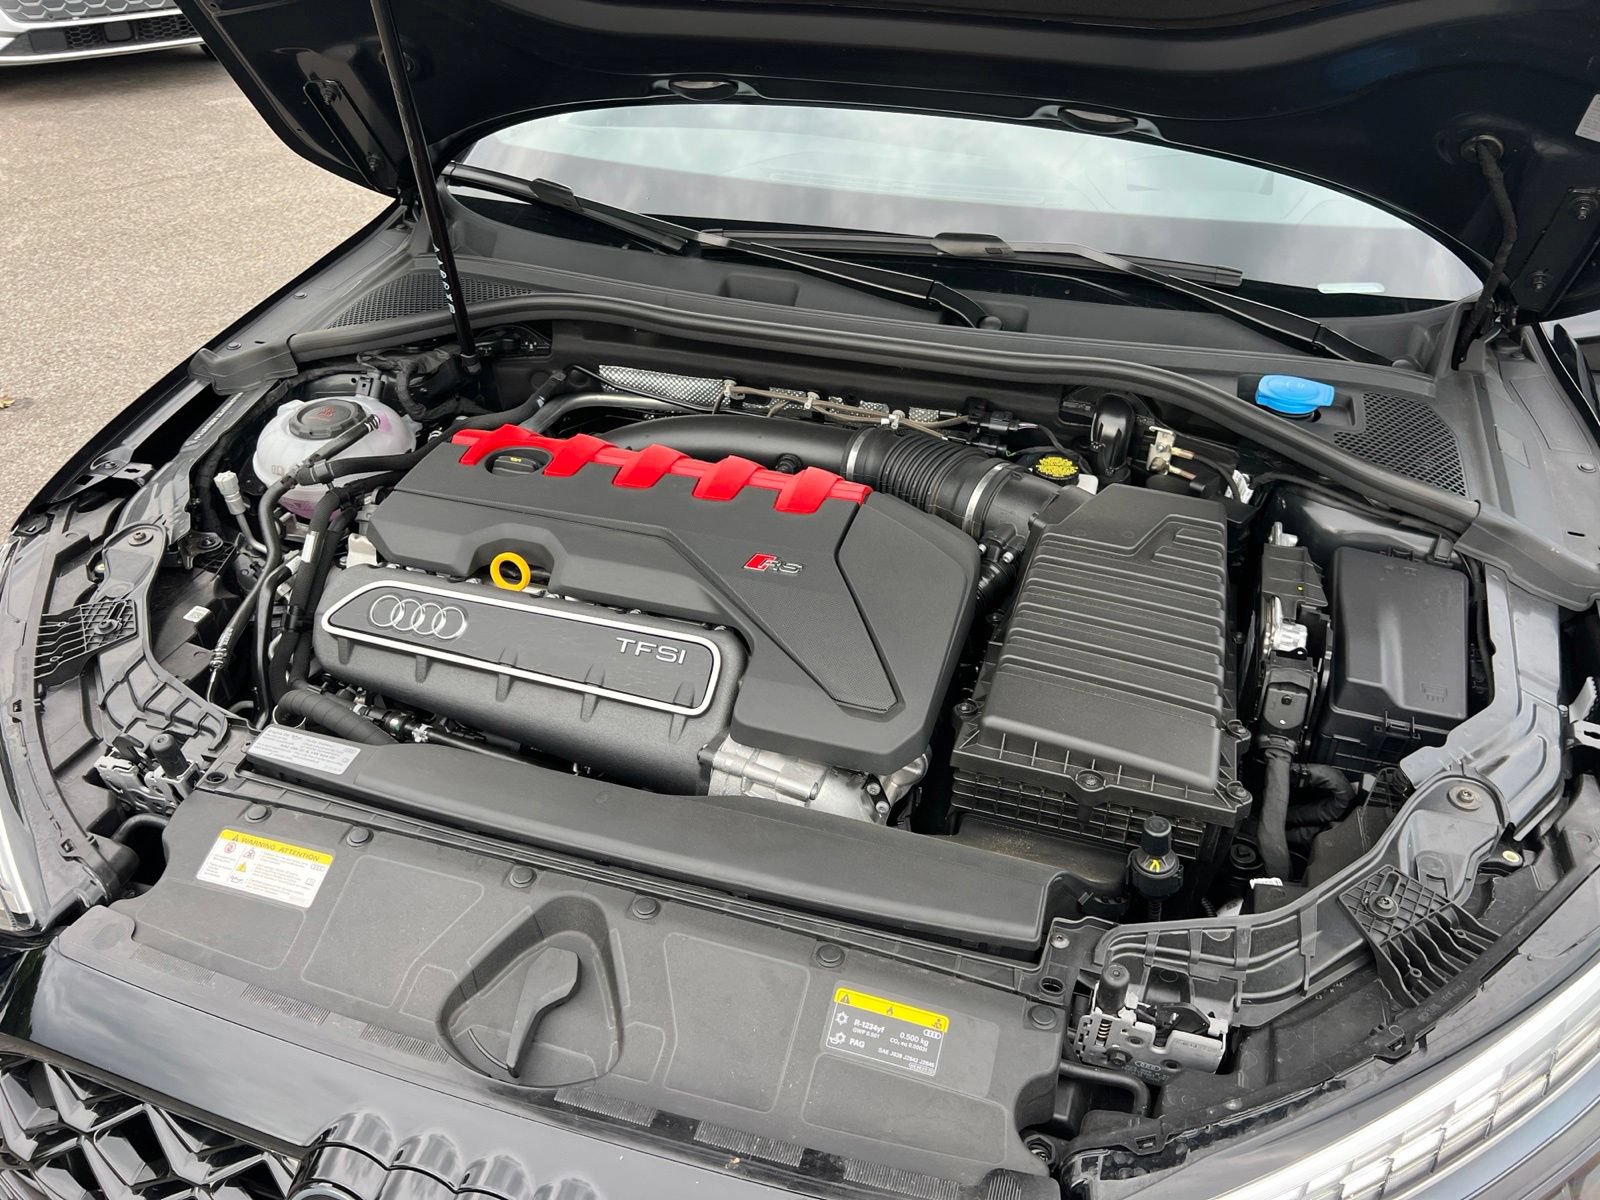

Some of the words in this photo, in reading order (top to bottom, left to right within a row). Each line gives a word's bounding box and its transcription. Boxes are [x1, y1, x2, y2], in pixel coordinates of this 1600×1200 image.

[616, 637, 687, 664] TFSI
[241, 838, 276, 851] WARNING
[279, 847, 321, 862] ATTENTION
[853, 1018, 885, 1033] R-1234yf
[849, 1038, 866, 1048] PAG
[899, 1031, 920, 1043] 0.500
[920, 1037, 929, 1047] kg
[877, 1047, 890, 1055] SAE
